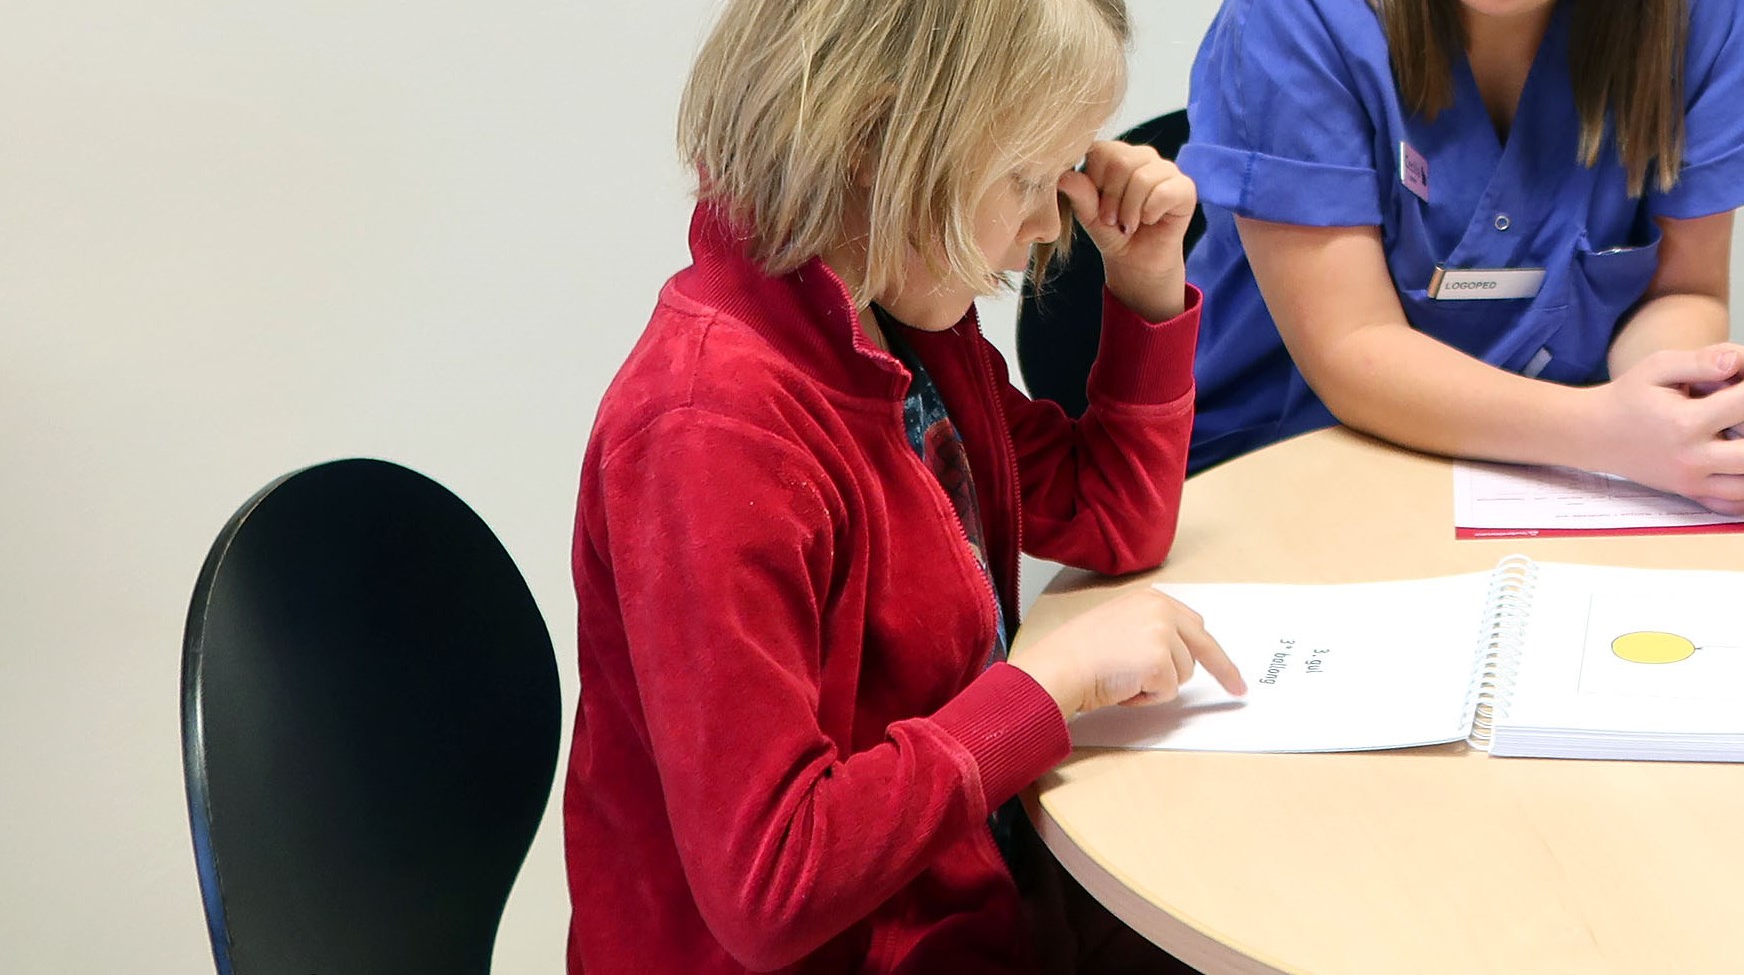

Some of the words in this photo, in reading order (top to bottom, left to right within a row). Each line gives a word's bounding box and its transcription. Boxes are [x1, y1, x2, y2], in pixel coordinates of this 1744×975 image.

[1445, 281, 1497, 291] LOGOPED
[1259, 652, 1292, 685] ballong
[1304, 659, 1324, 674] gul
